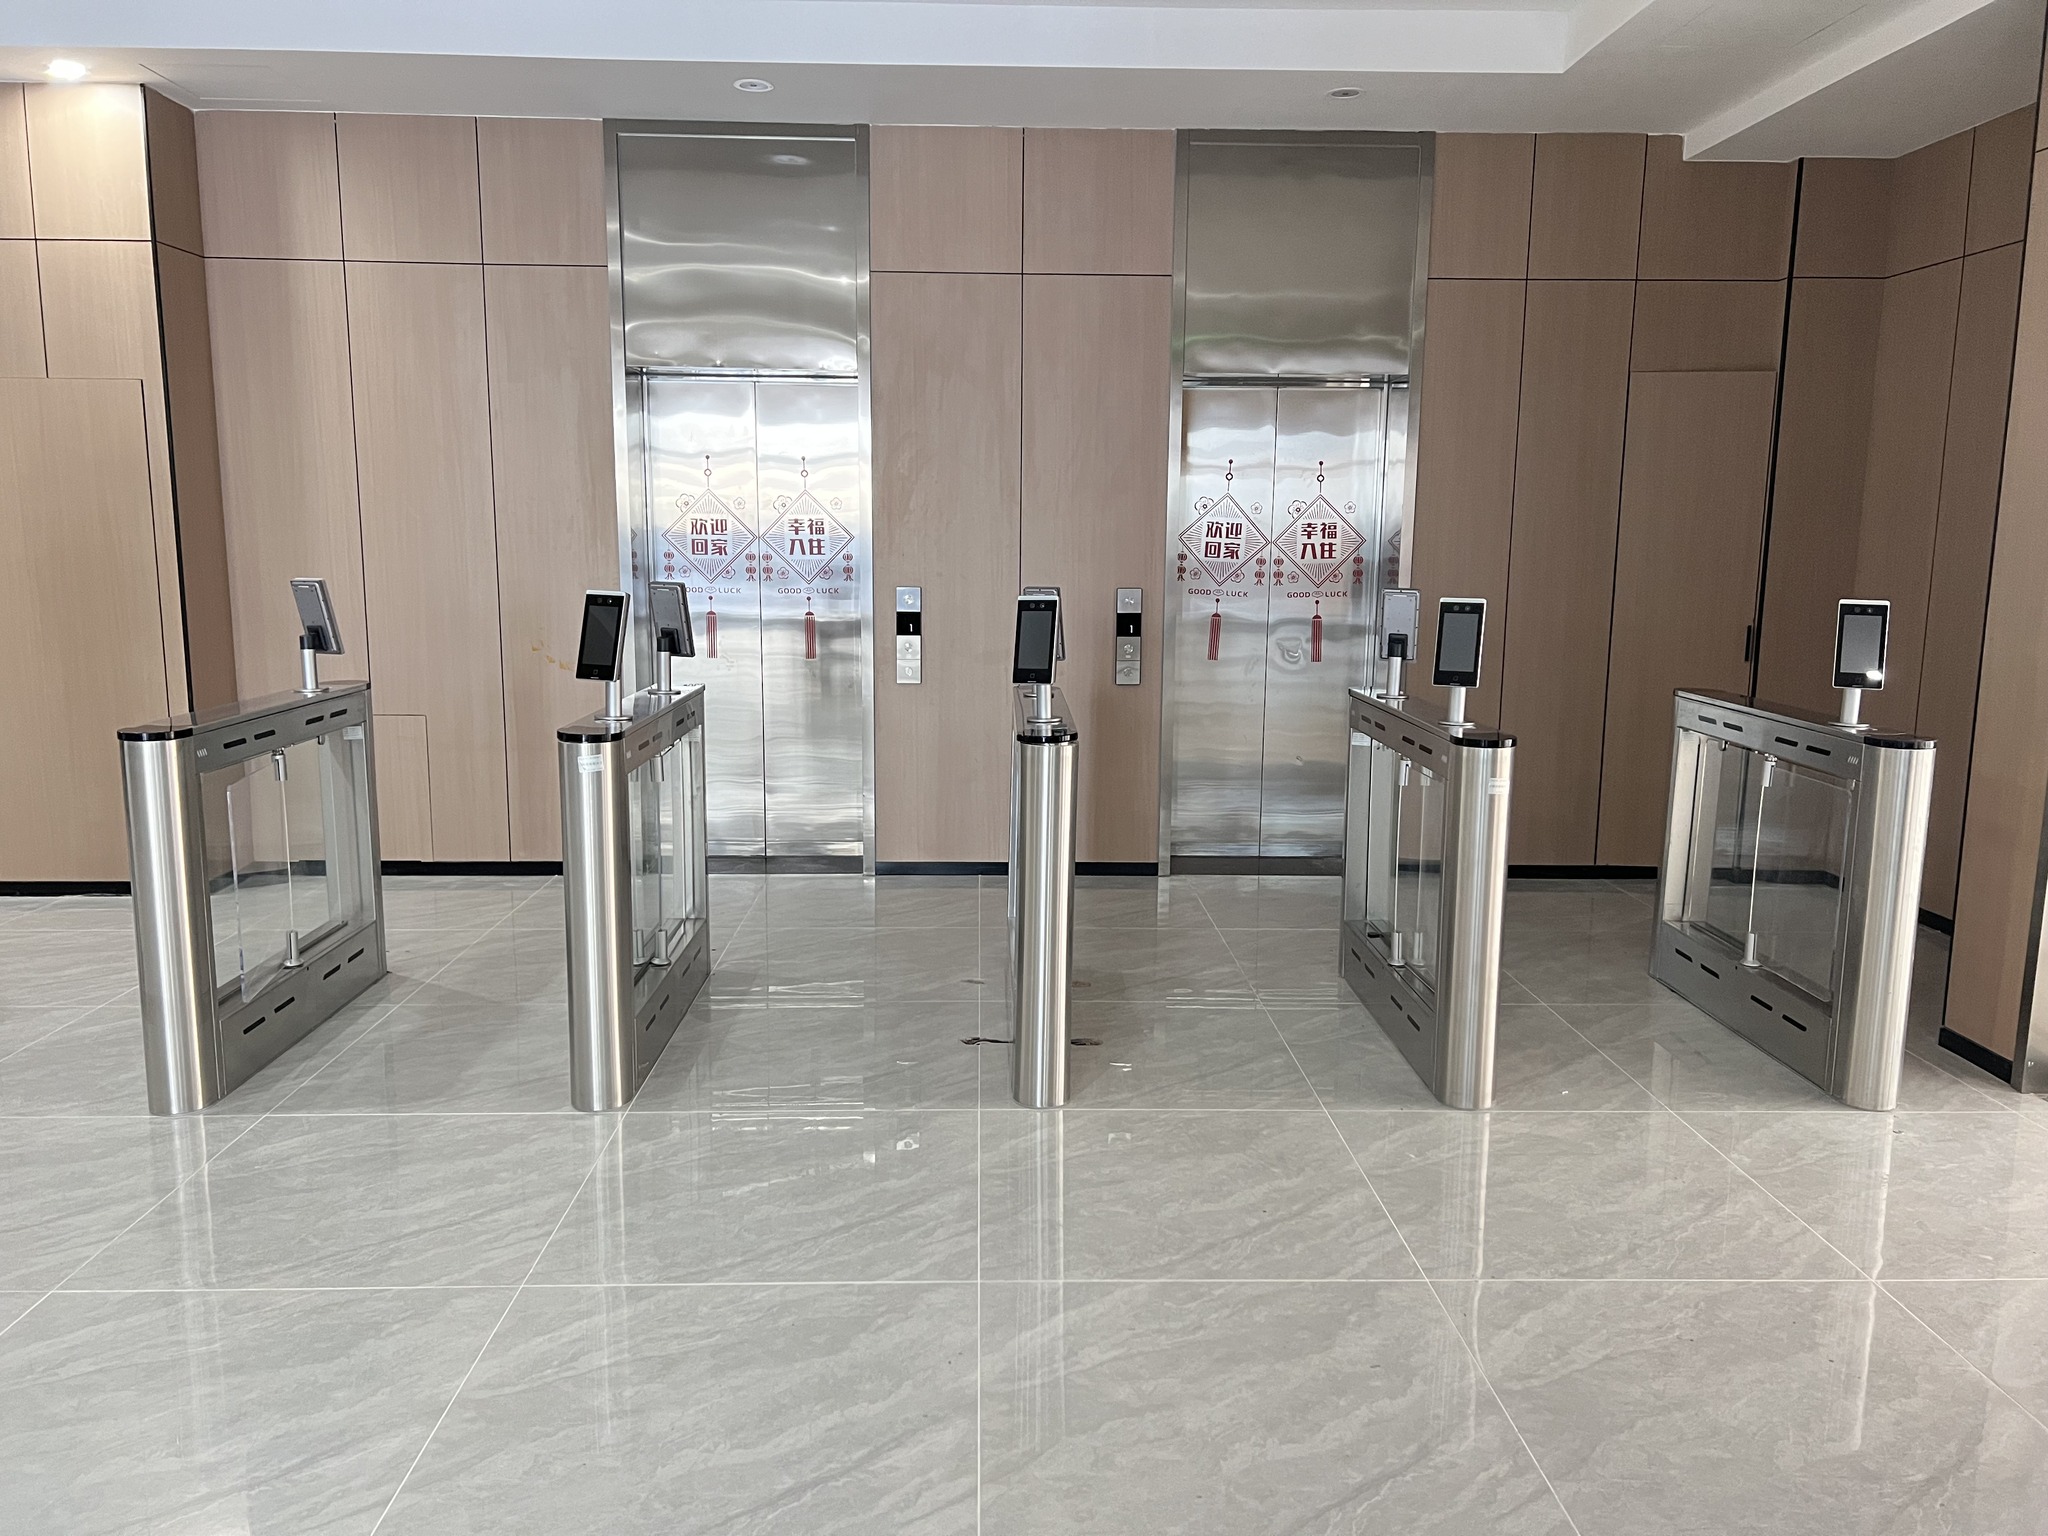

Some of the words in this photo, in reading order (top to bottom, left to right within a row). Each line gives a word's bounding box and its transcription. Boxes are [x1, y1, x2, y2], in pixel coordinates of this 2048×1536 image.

[690, 518, 728, 535] 欢迎
[788, 518, 825, 535] 幸福
[1206, 521, 1243, 540] 欢迎
[1301, 522, 1338, 540] 幸福
[691, 538, 728, 556] 回家
[789, 538, 826, 556] 入住
[1204, 541, 1241, 560] 回家
[1300, 542, 1338, 560] 入住
[1188, 588, 1212, 596] GOOD
[1226, 590, 1249, 598] LUCK
[1325, 590, 1348, 598] LUCK
[909, 623, 913, 632] 1
[1129, 624, 1133, 633] 1
